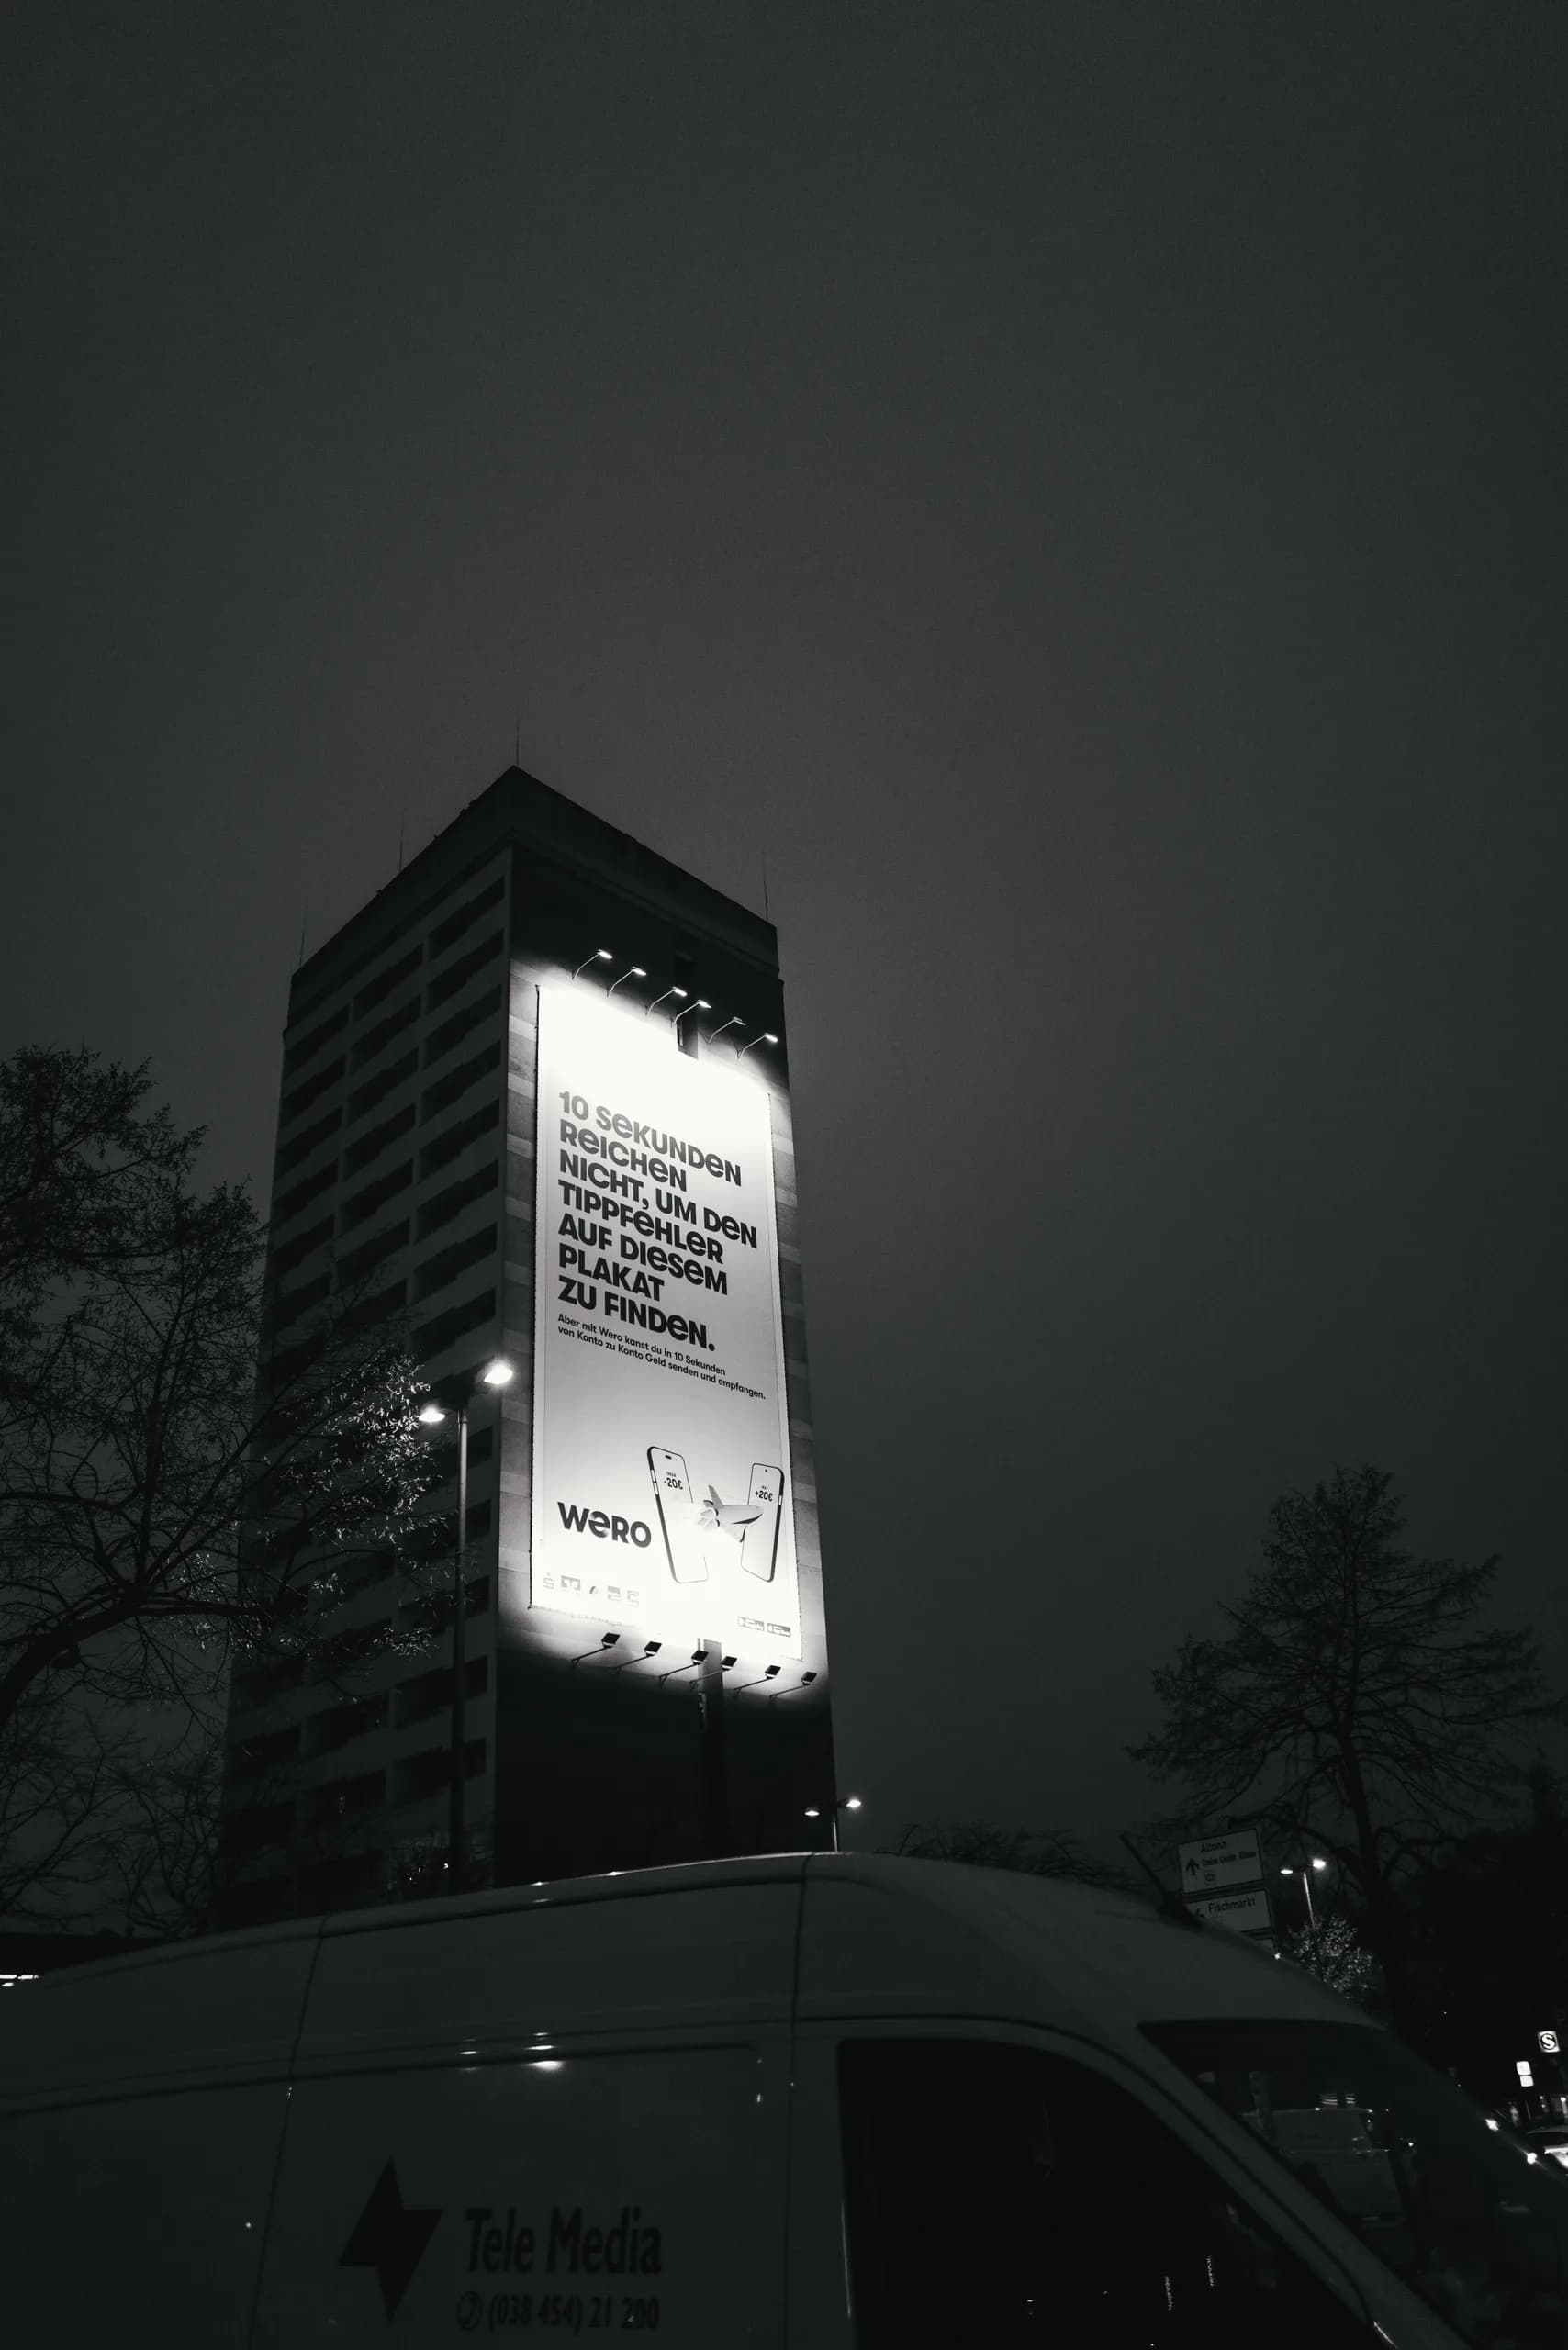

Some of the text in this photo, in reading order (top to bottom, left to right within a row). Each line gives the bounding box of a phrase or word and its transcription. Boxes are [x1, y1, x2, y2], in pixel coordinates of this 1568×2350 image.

[559, 1091, 588, 1120] 10
[560, 1148, 649, 1210] NICHT,
[655, 1188, 697, 1225] UM
[557, 1213, 612, 1250] AUF
[559, 1242, 665, 1302] PLAKAT
[558, 1275, 597, 1310] ZU
[557, 1326, 766, 1400] von Konto zu Konto Geld senden und empfangen.
[558, 1313, 580, 1327] Aber
[582, 1323, 597, 1334] mit
[599, 1326, 623, 1342] Wero
[651, 1344, 662, 1355] du
[664, 1348, 672, 1359] in
[674, 1351, 684, 1361] 10
[685, 1355, 726, 1376] Sekunden
[664, 1477, 683, 1490] -20€
[755, 1490, 773, 1502] +20€
[1208, 1897, 1256, 1913] Fischmarkt
[1541, 2033, 1556, 2050] S
[465, 2206, 662, 2275] Tele Media
[488, 2294, 533, 2334] (038
[588, 2296, 612, 2329] 21
[622, 2296, 661, 2329] 200
